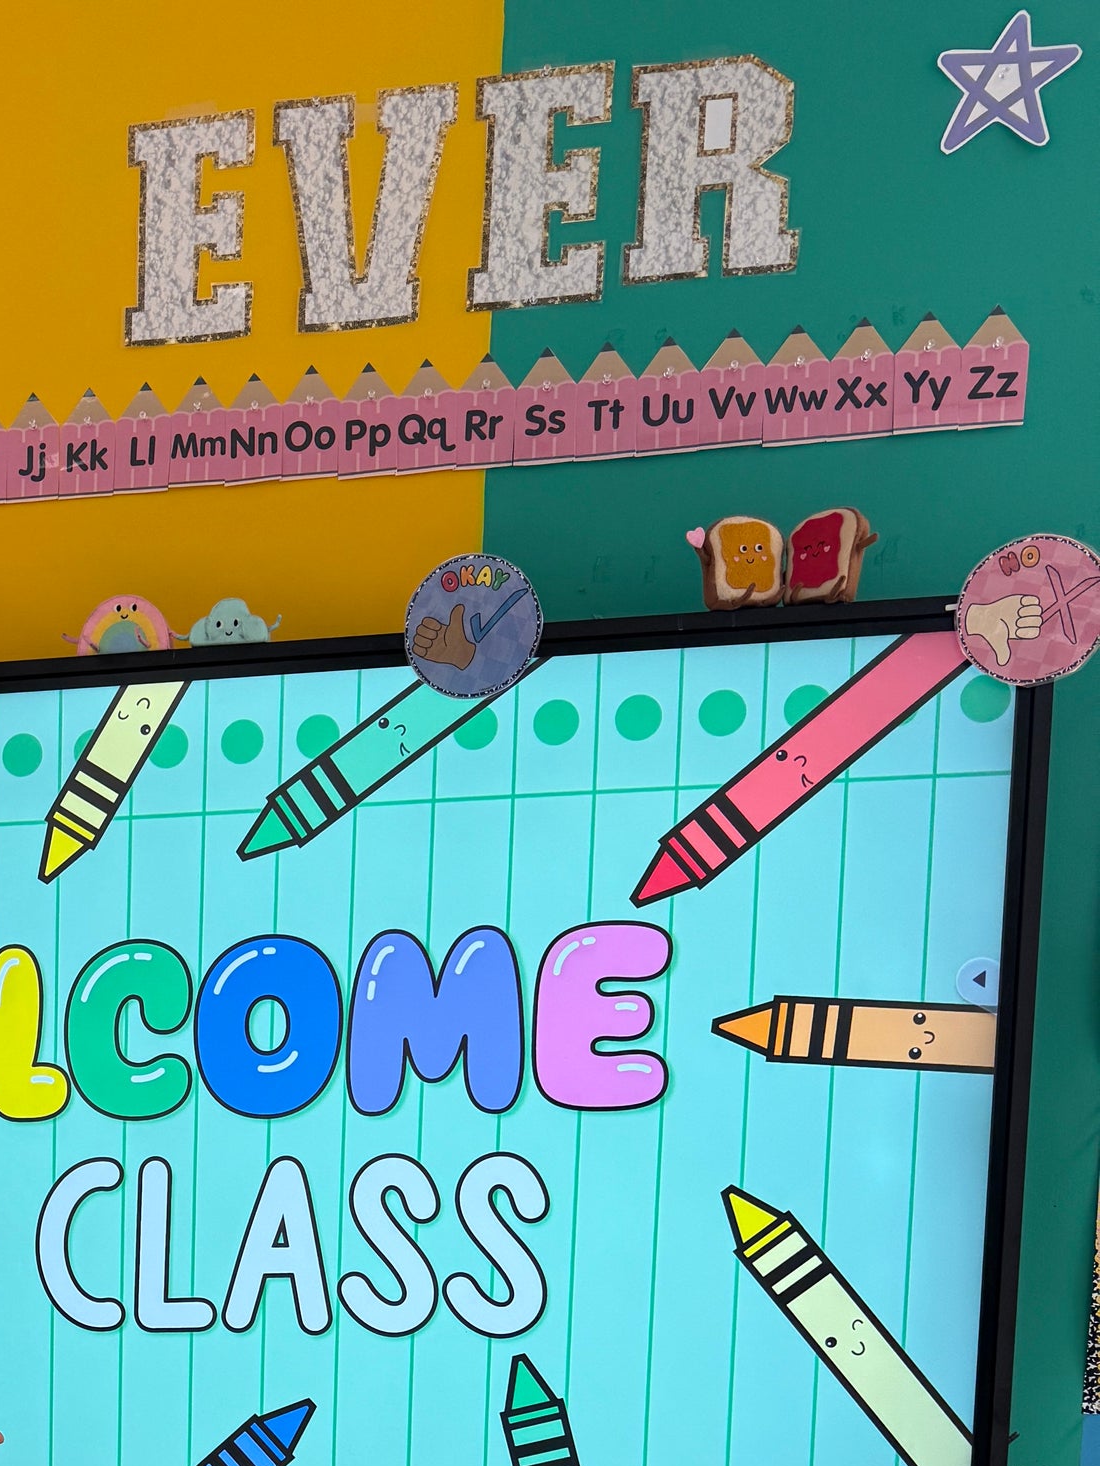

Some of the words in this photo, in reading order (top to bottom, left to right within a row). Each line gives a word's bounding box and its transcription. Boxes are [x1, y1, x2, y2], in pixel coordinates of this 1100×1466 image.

[124, 54, 802, 347] EVER
[19, 443, 47, 482] Jj
[67, 441, 109, 473] Kk
[130, 434, 156, 466] Ll
[171, 432, 227, 460] Mm
[230, 426, 278, 460] Nn
[285, 420, 337, 452] Oo
[345, 419, 391, 457] Pp
[399, 413, 456, 452] Qq
[465, 409, 503, 441] Rr
[524, 404, 566, 437] Ss
[588, 399, 625, 432] Tt
[642, 394, 694, 428] Uu
[708, 386, 757, 420] Vv
[764, 385, 829, 415] Ww
[835, 376, 888, 410] Xx
[904, 370, 952, 411] Yy
[968, 366, 1019, 400] Zz
[441, 564, 510, 592] OKAY
[999, 545, 1040, 576] NO
[35, 1151, 551, 1337] CLASS
